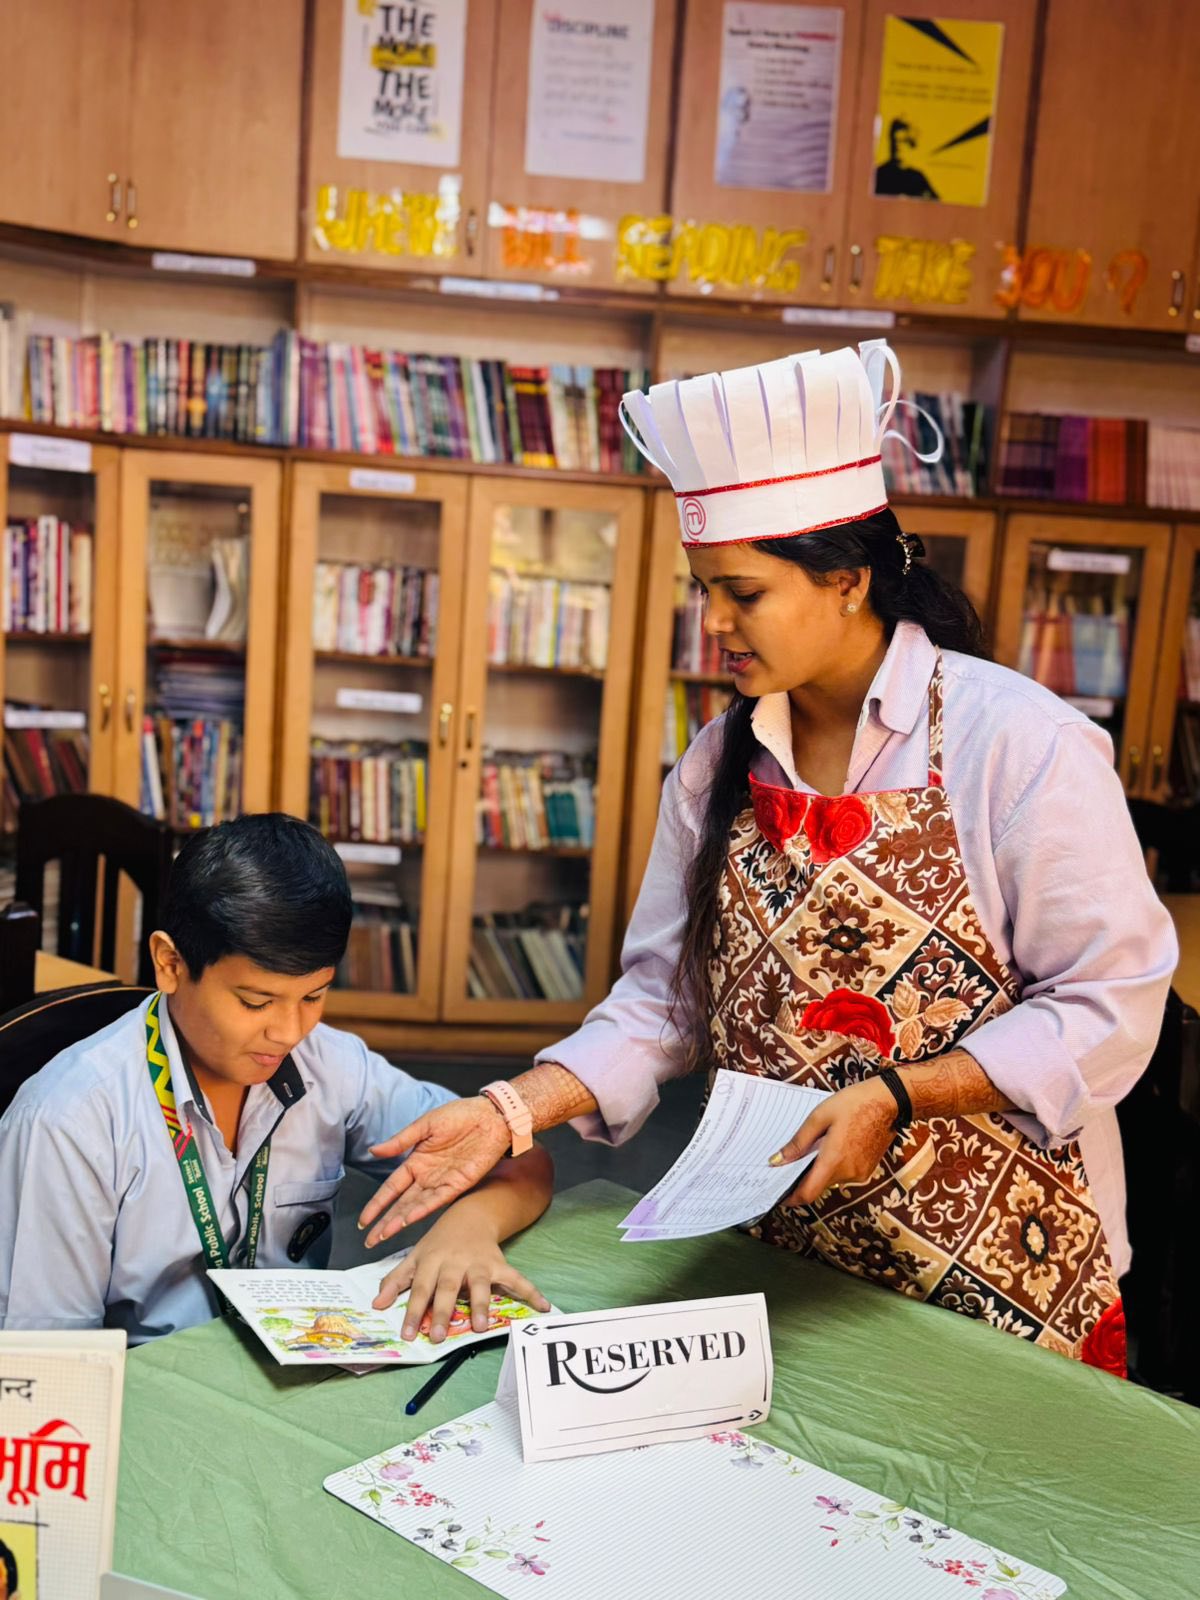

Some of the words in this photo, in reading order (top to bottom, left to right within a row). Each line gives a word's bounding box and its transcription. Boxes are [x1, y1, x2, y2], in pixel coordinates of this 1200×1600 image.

[379, 4, 437, 36] THE
[378, 68, 431, 99] THE
[874, 236, 977, 304] TAKE
[192, 1186, 212, 1223] School
[254, 1173, 265, 1208] School
[204, 1223, 221, 1258] Public
[249, 1212, 261, 1245] Public
[542, 1330, 746, 1394] RESERVED
